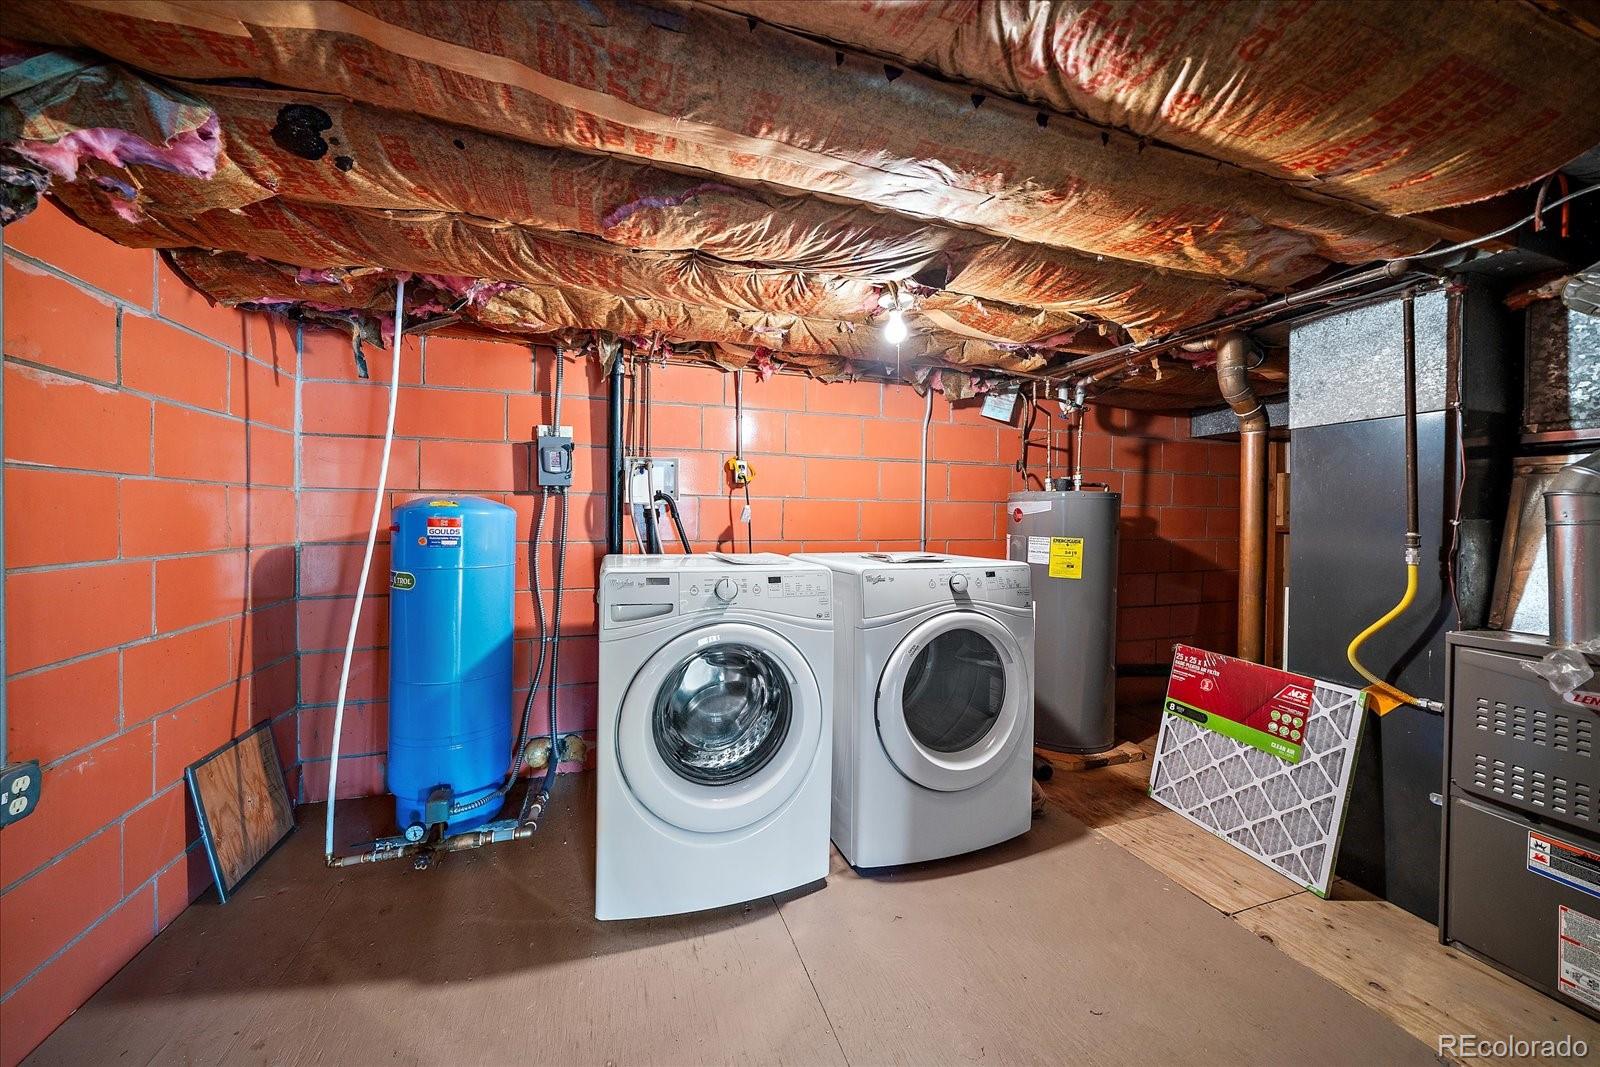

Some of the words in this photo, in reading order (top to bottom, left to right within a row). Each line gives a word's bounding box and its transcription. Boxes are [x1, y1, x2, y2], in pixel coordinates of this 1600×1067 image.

[1175, 652, 1184, 660] 25
[1189, 656, 1198, 664] 25
[1287, 688, 1308, 701] ACE
[1169, 703, 1176, 711] 8
[1270, 742, 1286, 752] CLEAN
